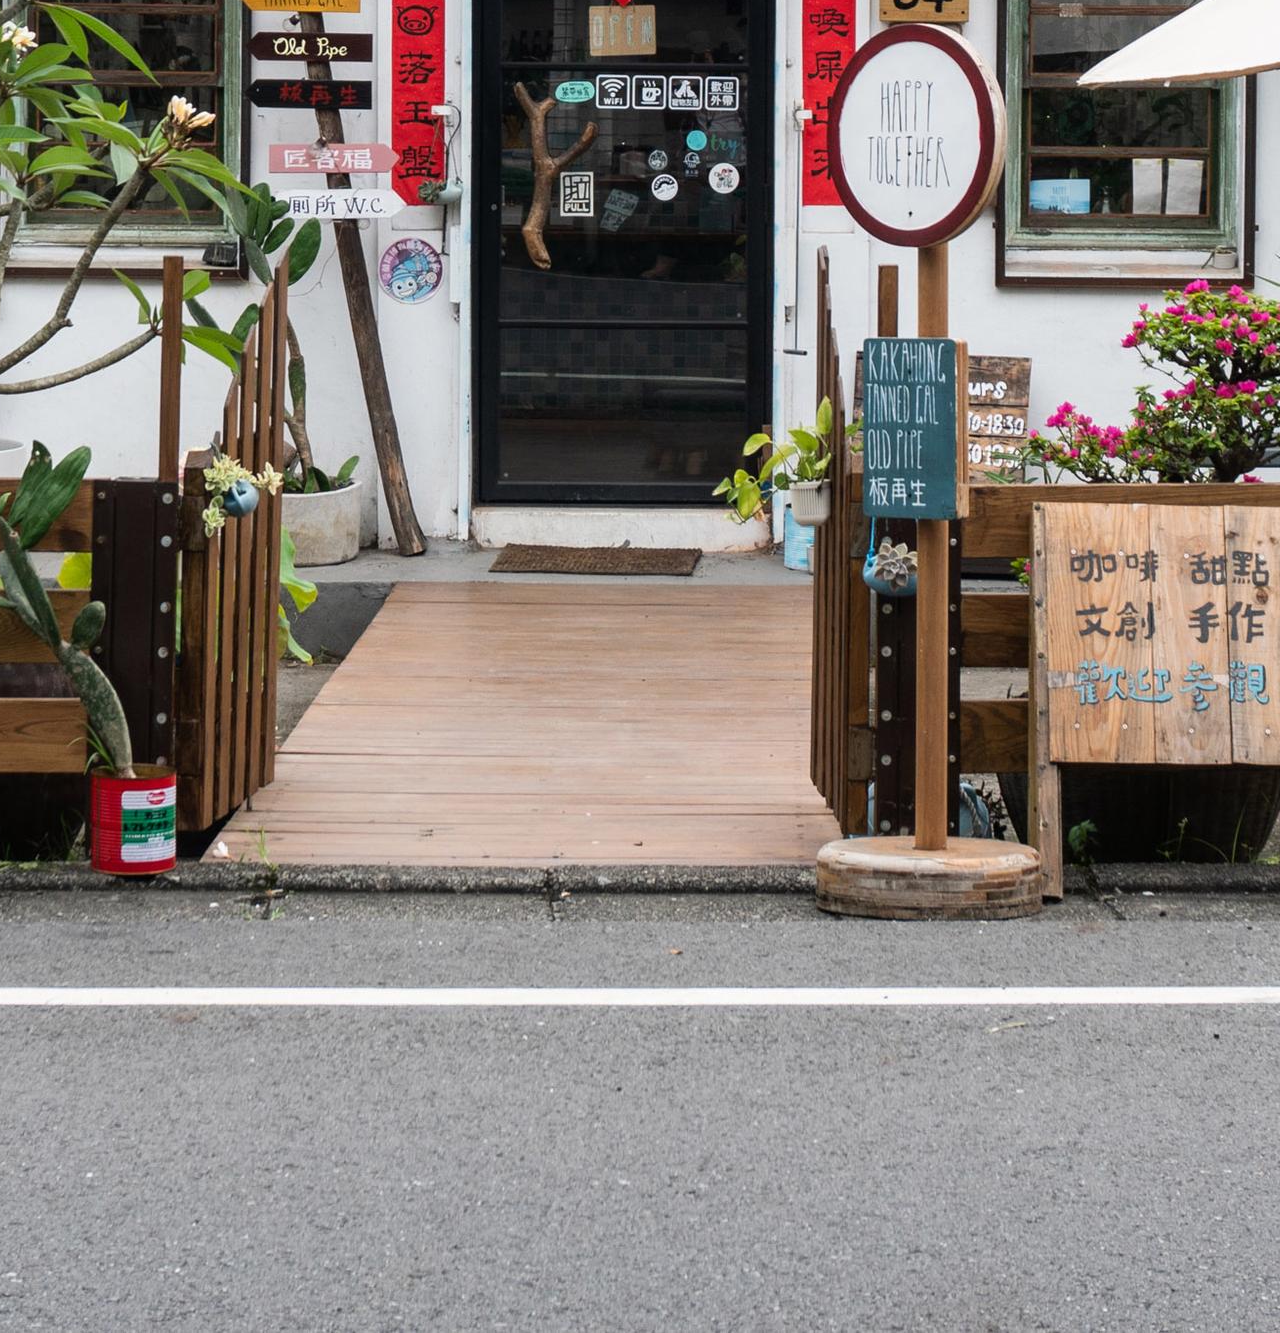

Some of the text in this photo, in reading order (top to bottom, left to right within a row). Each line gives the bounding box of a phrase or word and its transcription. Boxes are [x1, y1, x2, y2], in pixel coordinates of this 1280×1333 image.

[273, 36, 348, 60] Old Pipe
[592, 15, 652, 48] OPEN
[710, 95, 734, 106] 外帶
[711, 81, 734, 93] 歡迎
[880, 80, 933, 133] HAPPY
[868, 135, 950, 188] TOGETHER
[564, 202, 590, 212] PULL
[869, 341, 946, 383] KAKAHONG
[866, 383, 910, 424] TANNED
[867, 429, 923, 469] OLD PIPE
[869, 477, 927, 507] 板再生
[1070, 550, 1270, 586] 咖啡 甜點
[1075, 601, 1266, 643] 文創 手作
